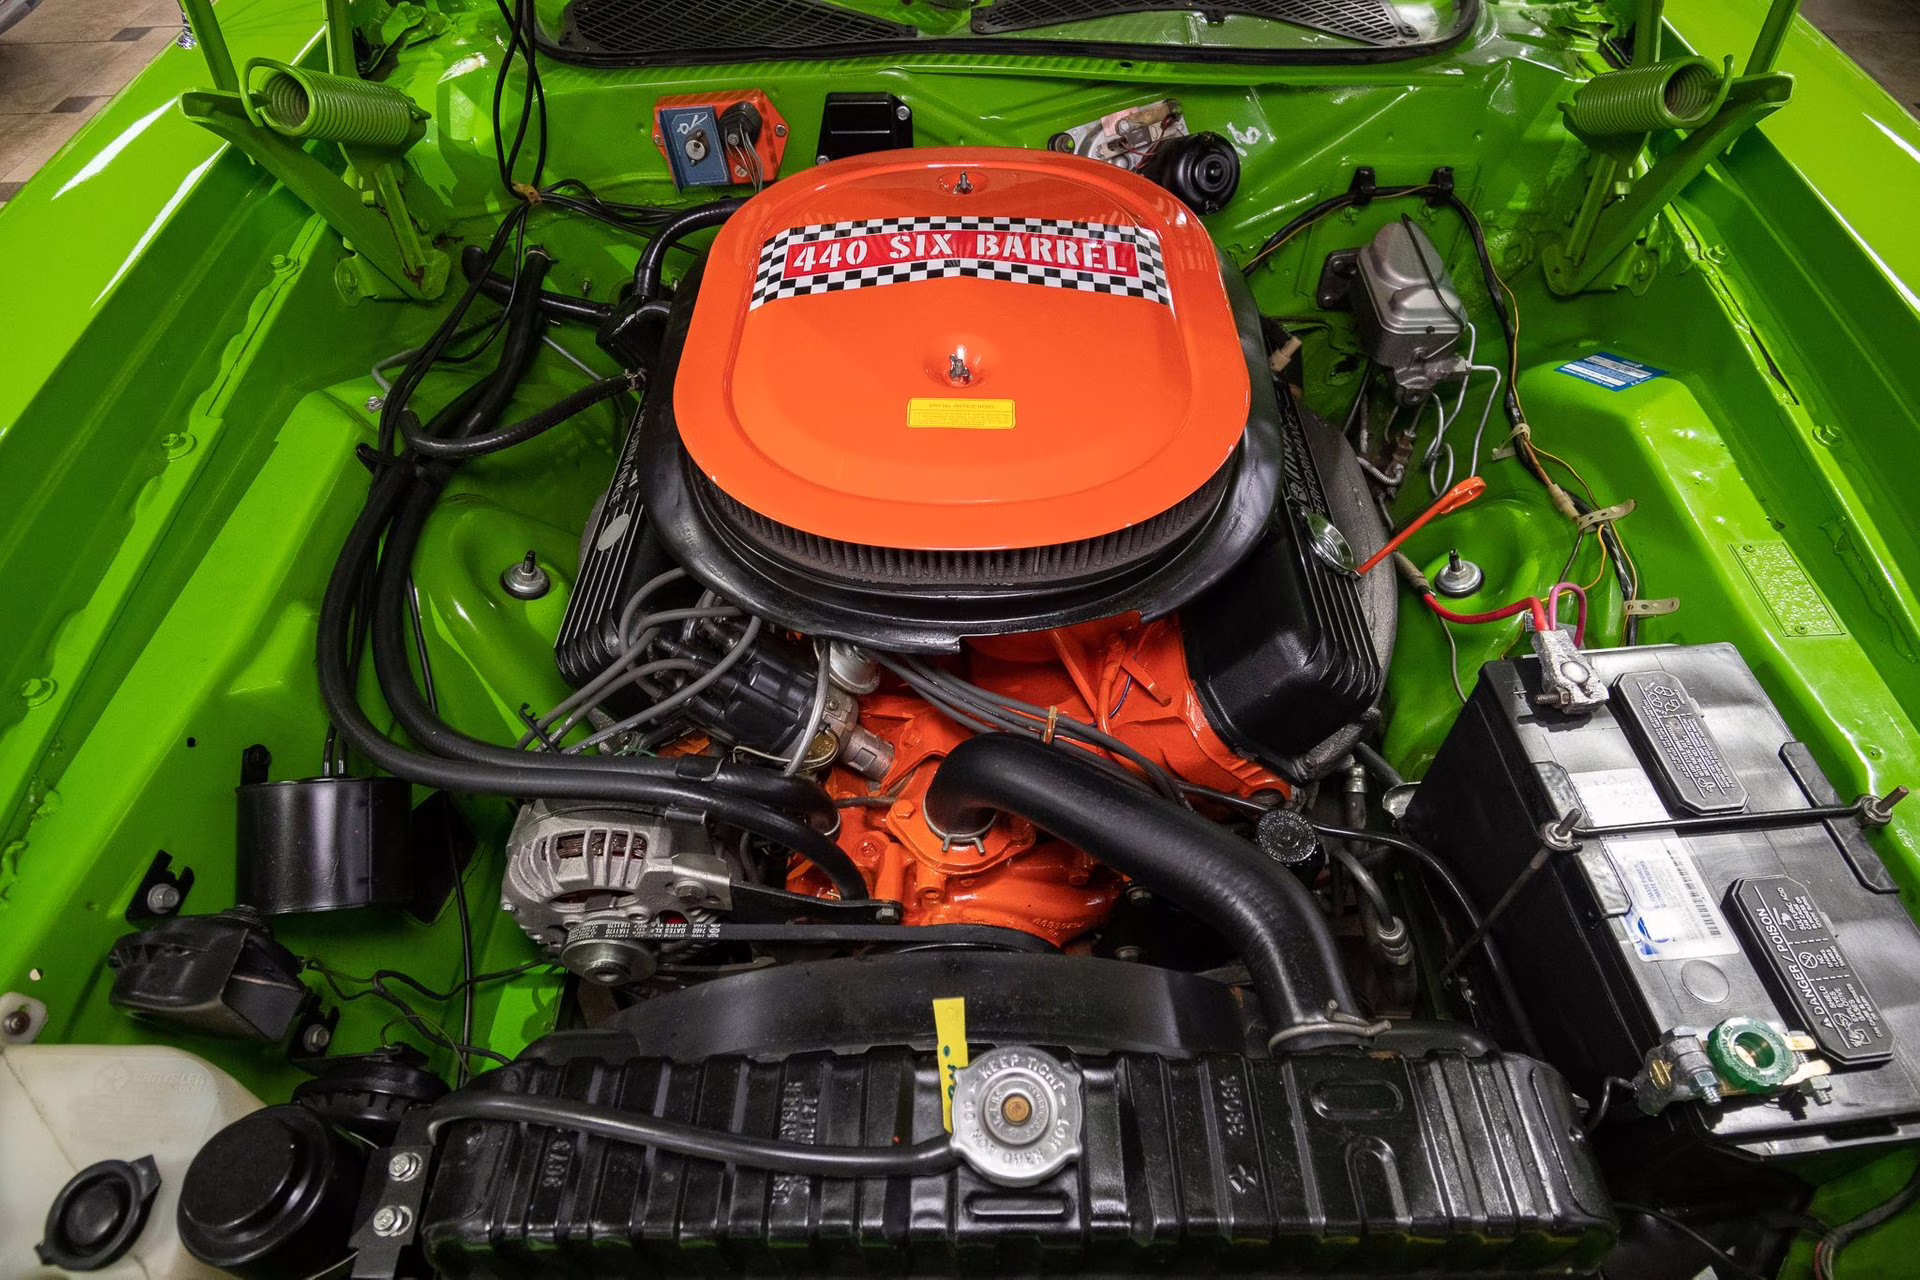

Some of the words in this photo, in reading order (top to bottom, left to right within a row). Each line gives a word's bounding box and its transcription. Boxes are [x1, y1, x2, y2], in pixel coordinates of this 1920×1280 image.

[793, 239, 869, 273] 440
[889, 233, 954, 260] SIX
[976, 232, 1128, 273] BARREL
[1776, 887, 1789, 901] ACID
[1755, 908, 1787, 952] POISON
[1787, 964, 1825, 1014] DANGER
[1818, 985, 1836, 1008] SHIELD
[979, 1054, 1020, 1079] KEEP
[1026, 1056, 1066, 1090] TIGHT
